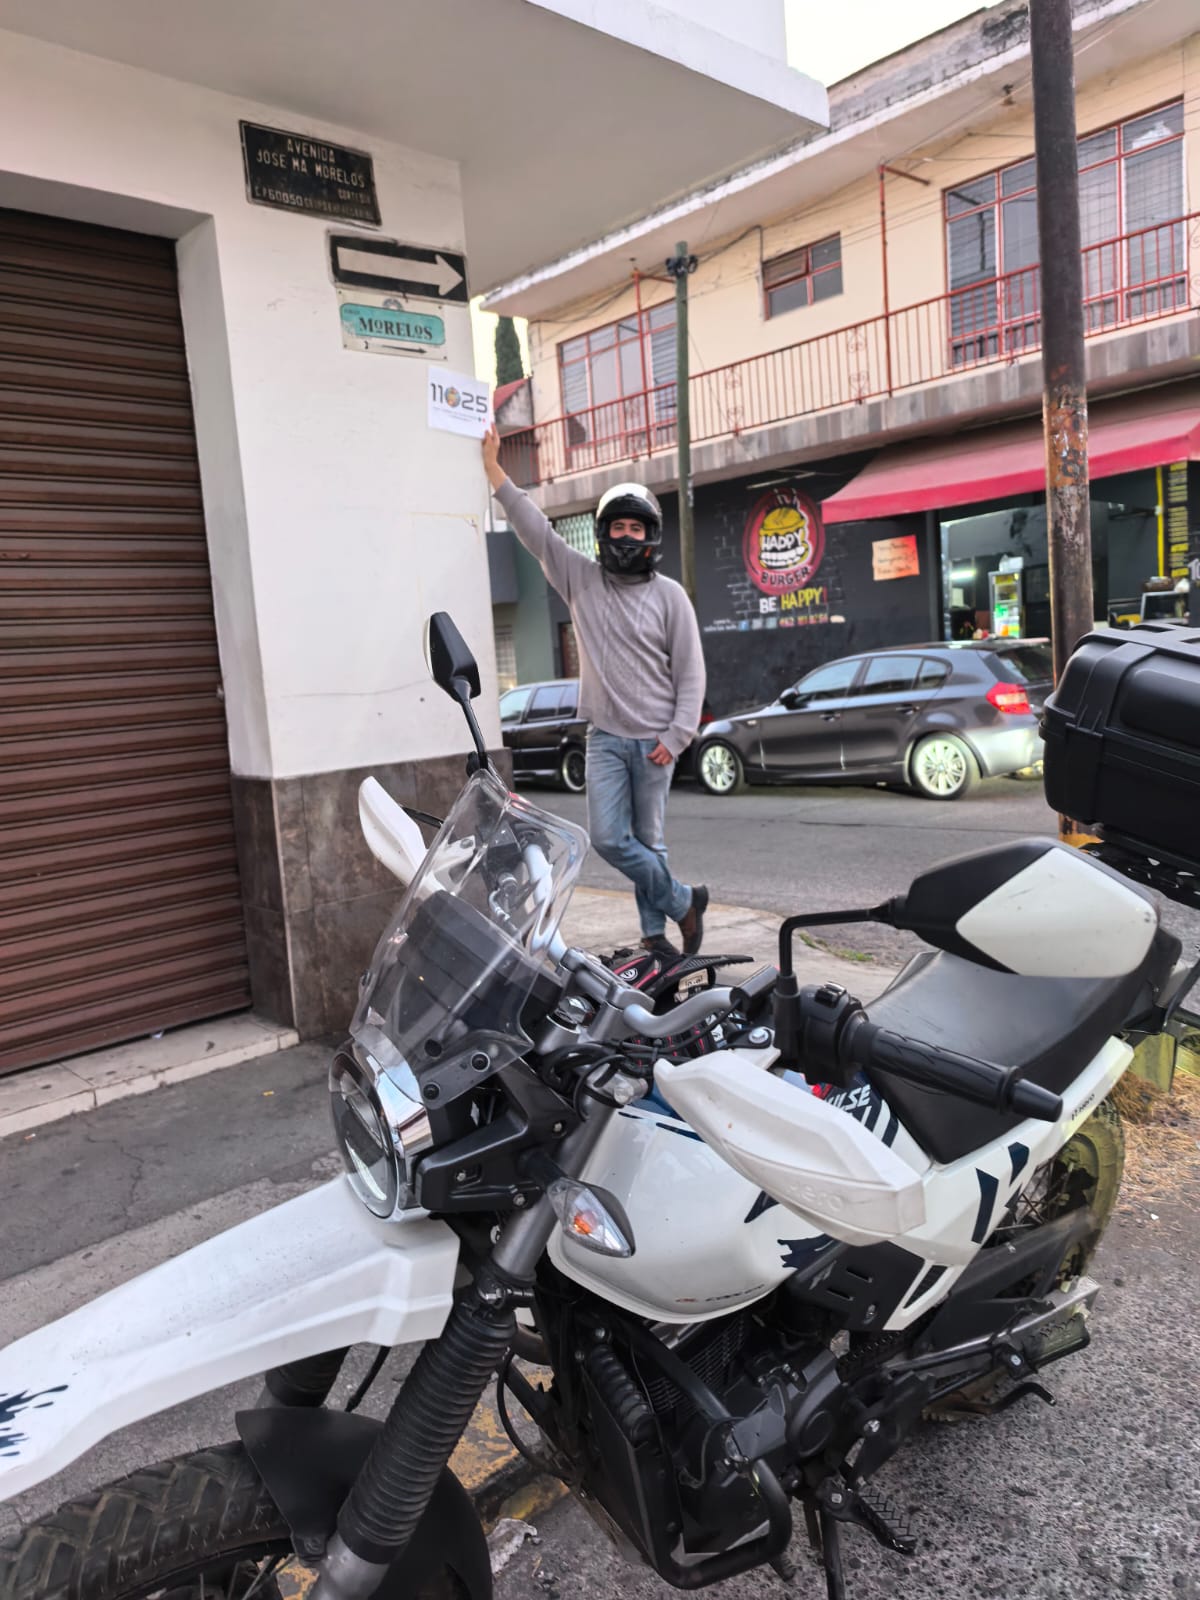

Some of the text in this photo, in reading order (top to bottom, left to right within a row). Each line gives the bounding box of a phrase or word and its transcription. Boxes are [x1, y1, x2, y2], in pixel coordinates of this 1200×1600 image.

[287, 138, 336, 163] AVENIDA
[256, 149, 287, 169] JOSE
[315, 163, 365, 188] MORELOS
[358, 316, 433, 341] MORELOS
[762, 528, 804, 551] HAPPY
[761, 566, 810, 585] BURGER
[759, 597, 777, 614] BE
